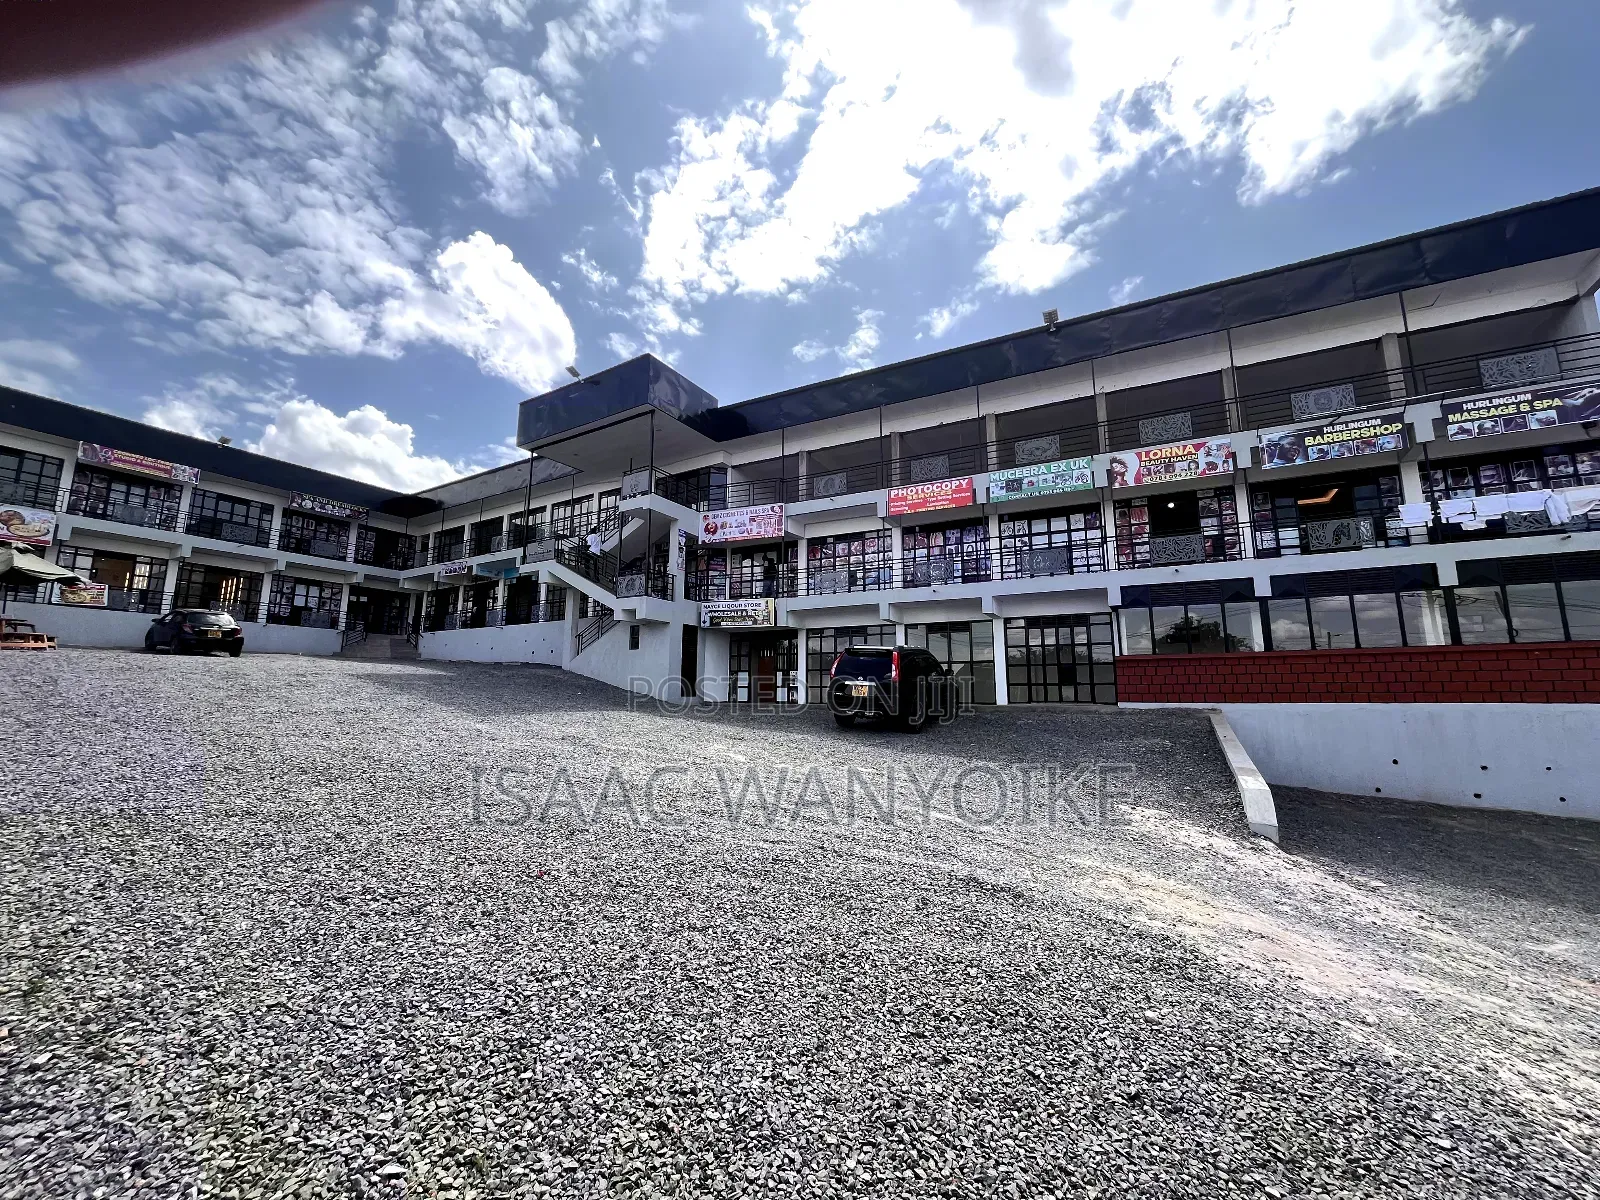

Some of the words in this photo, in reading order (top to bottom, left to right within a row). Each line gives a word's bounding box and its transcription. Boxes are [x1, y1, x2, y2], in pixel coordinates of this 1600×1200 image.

[1462, 393, 1532, 410] HURLINGUM
[1448, 403, 1517, 423] MASSAGE
[1519, 402, 1531, 412] &
[1532, 397, 1564, 410] SPA
[1323, 418, 1382, 433] HURLINGUM
[1304, 422, 1403, 446] BARBERSHOP
[1141, 444, 1196, 460] LORNA
[1050, 462, 1067, 473] EX
[1070, 458, 1089, 469] UK
[1140, 458, 1169, 467] BEAUTY
[1170, 454, 1198, 462] HAVEN
[890, 478, 969, 499] PHOTOCOPY
[907, 489, 952, 501] SERVICES
